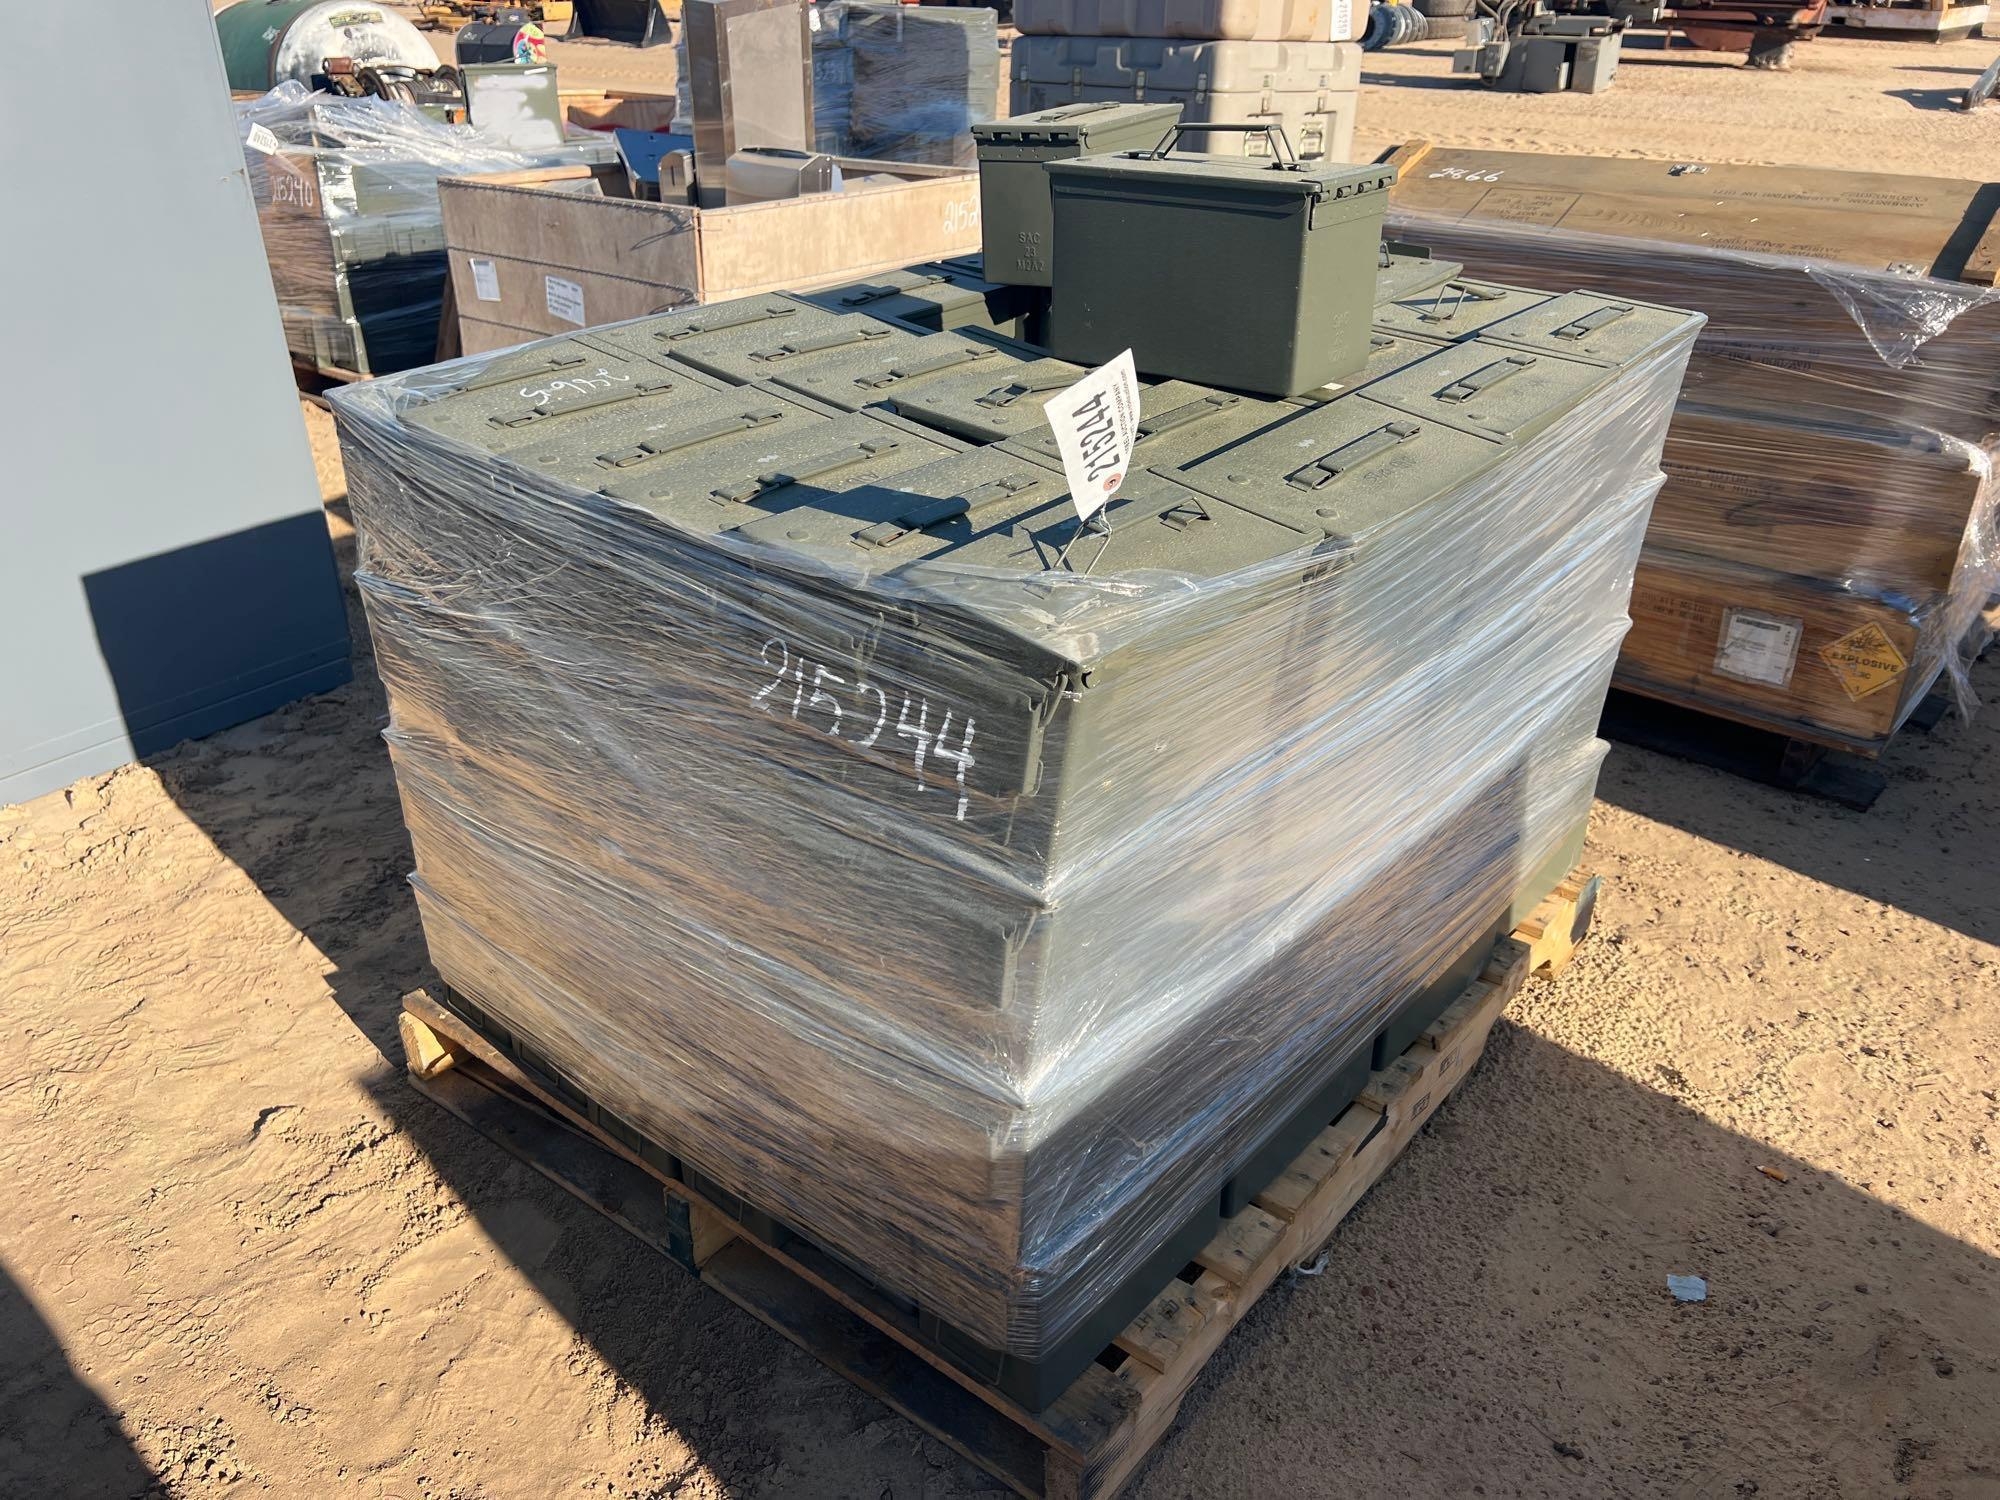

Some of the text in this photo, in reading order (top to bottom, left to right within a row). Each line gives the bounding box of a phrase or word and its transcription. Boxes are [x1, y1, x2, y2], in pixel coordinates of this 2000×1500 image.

[271, 174, 314, 207] 215240
[1018, 231, 1041, 245] SAC
[1023, 246, 1037, 258] 23
[1072, 391, 1120, 482] 215244
[1831, 651, 1899, 674] EXPLOSIVE
